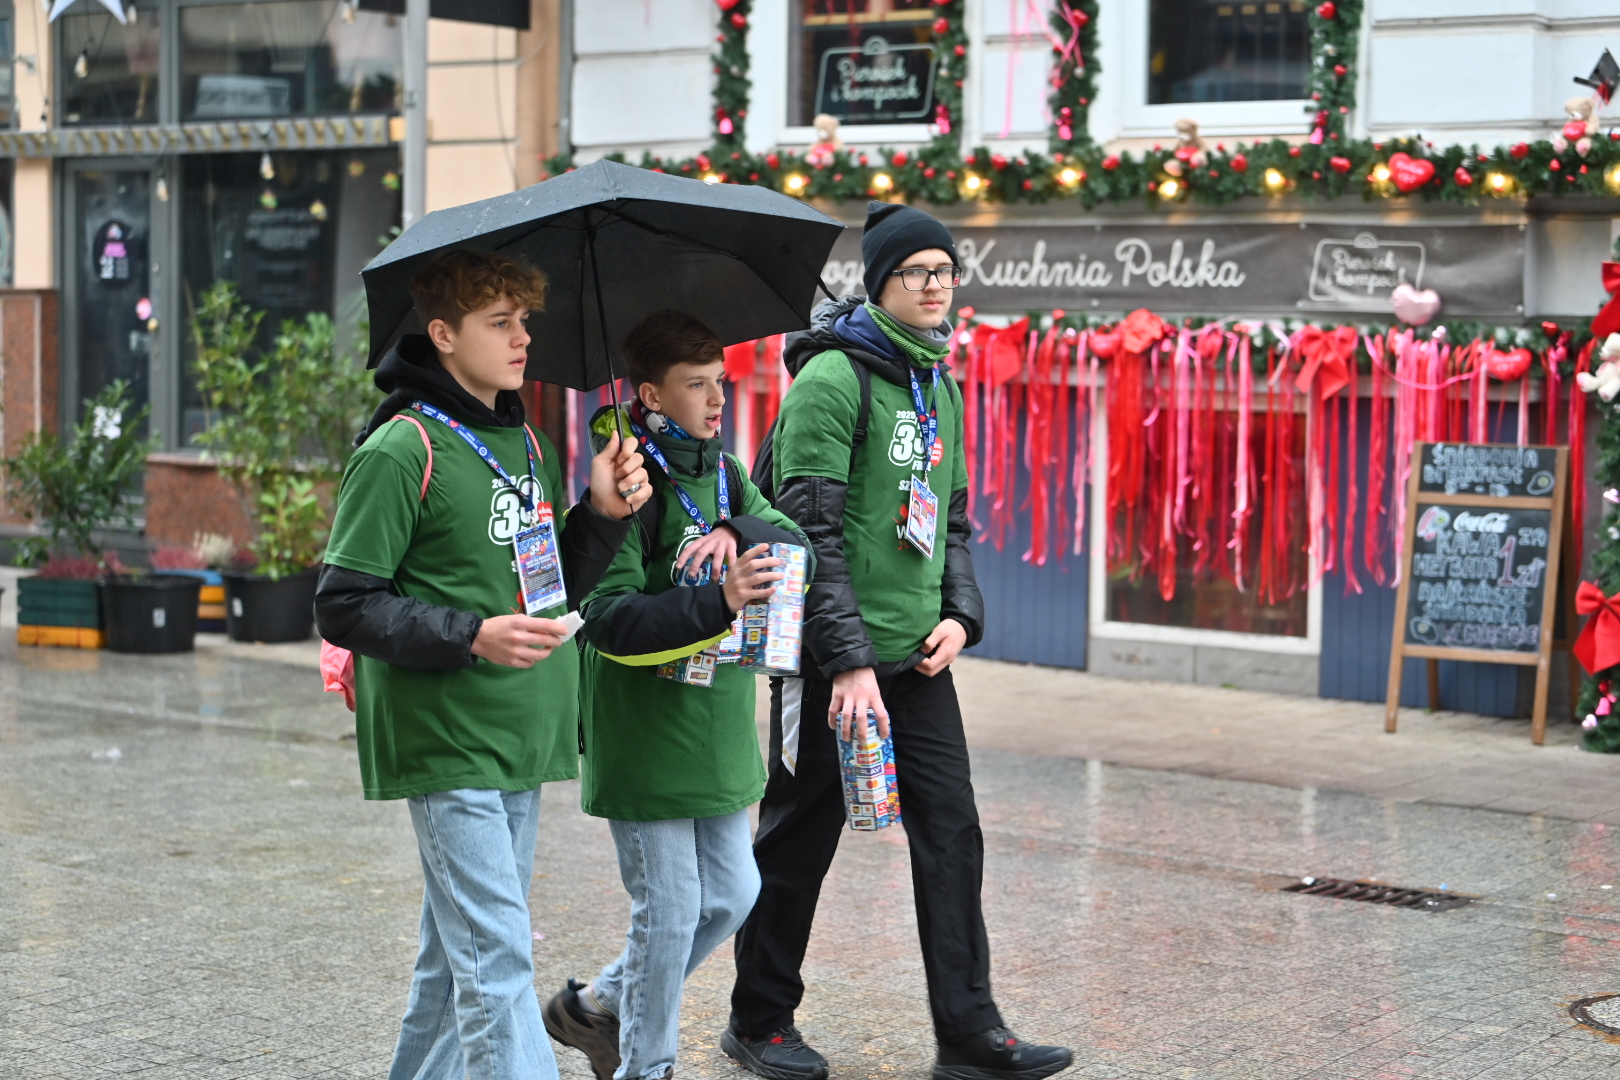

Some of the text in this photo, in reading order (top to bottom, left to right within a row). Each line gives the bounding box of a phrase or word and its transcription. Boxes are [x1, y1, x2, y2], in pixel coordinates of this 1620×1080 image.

[957, 237, 1246, 288] Kuchnia Polska
[1498, 534, 1517, 588] 1
